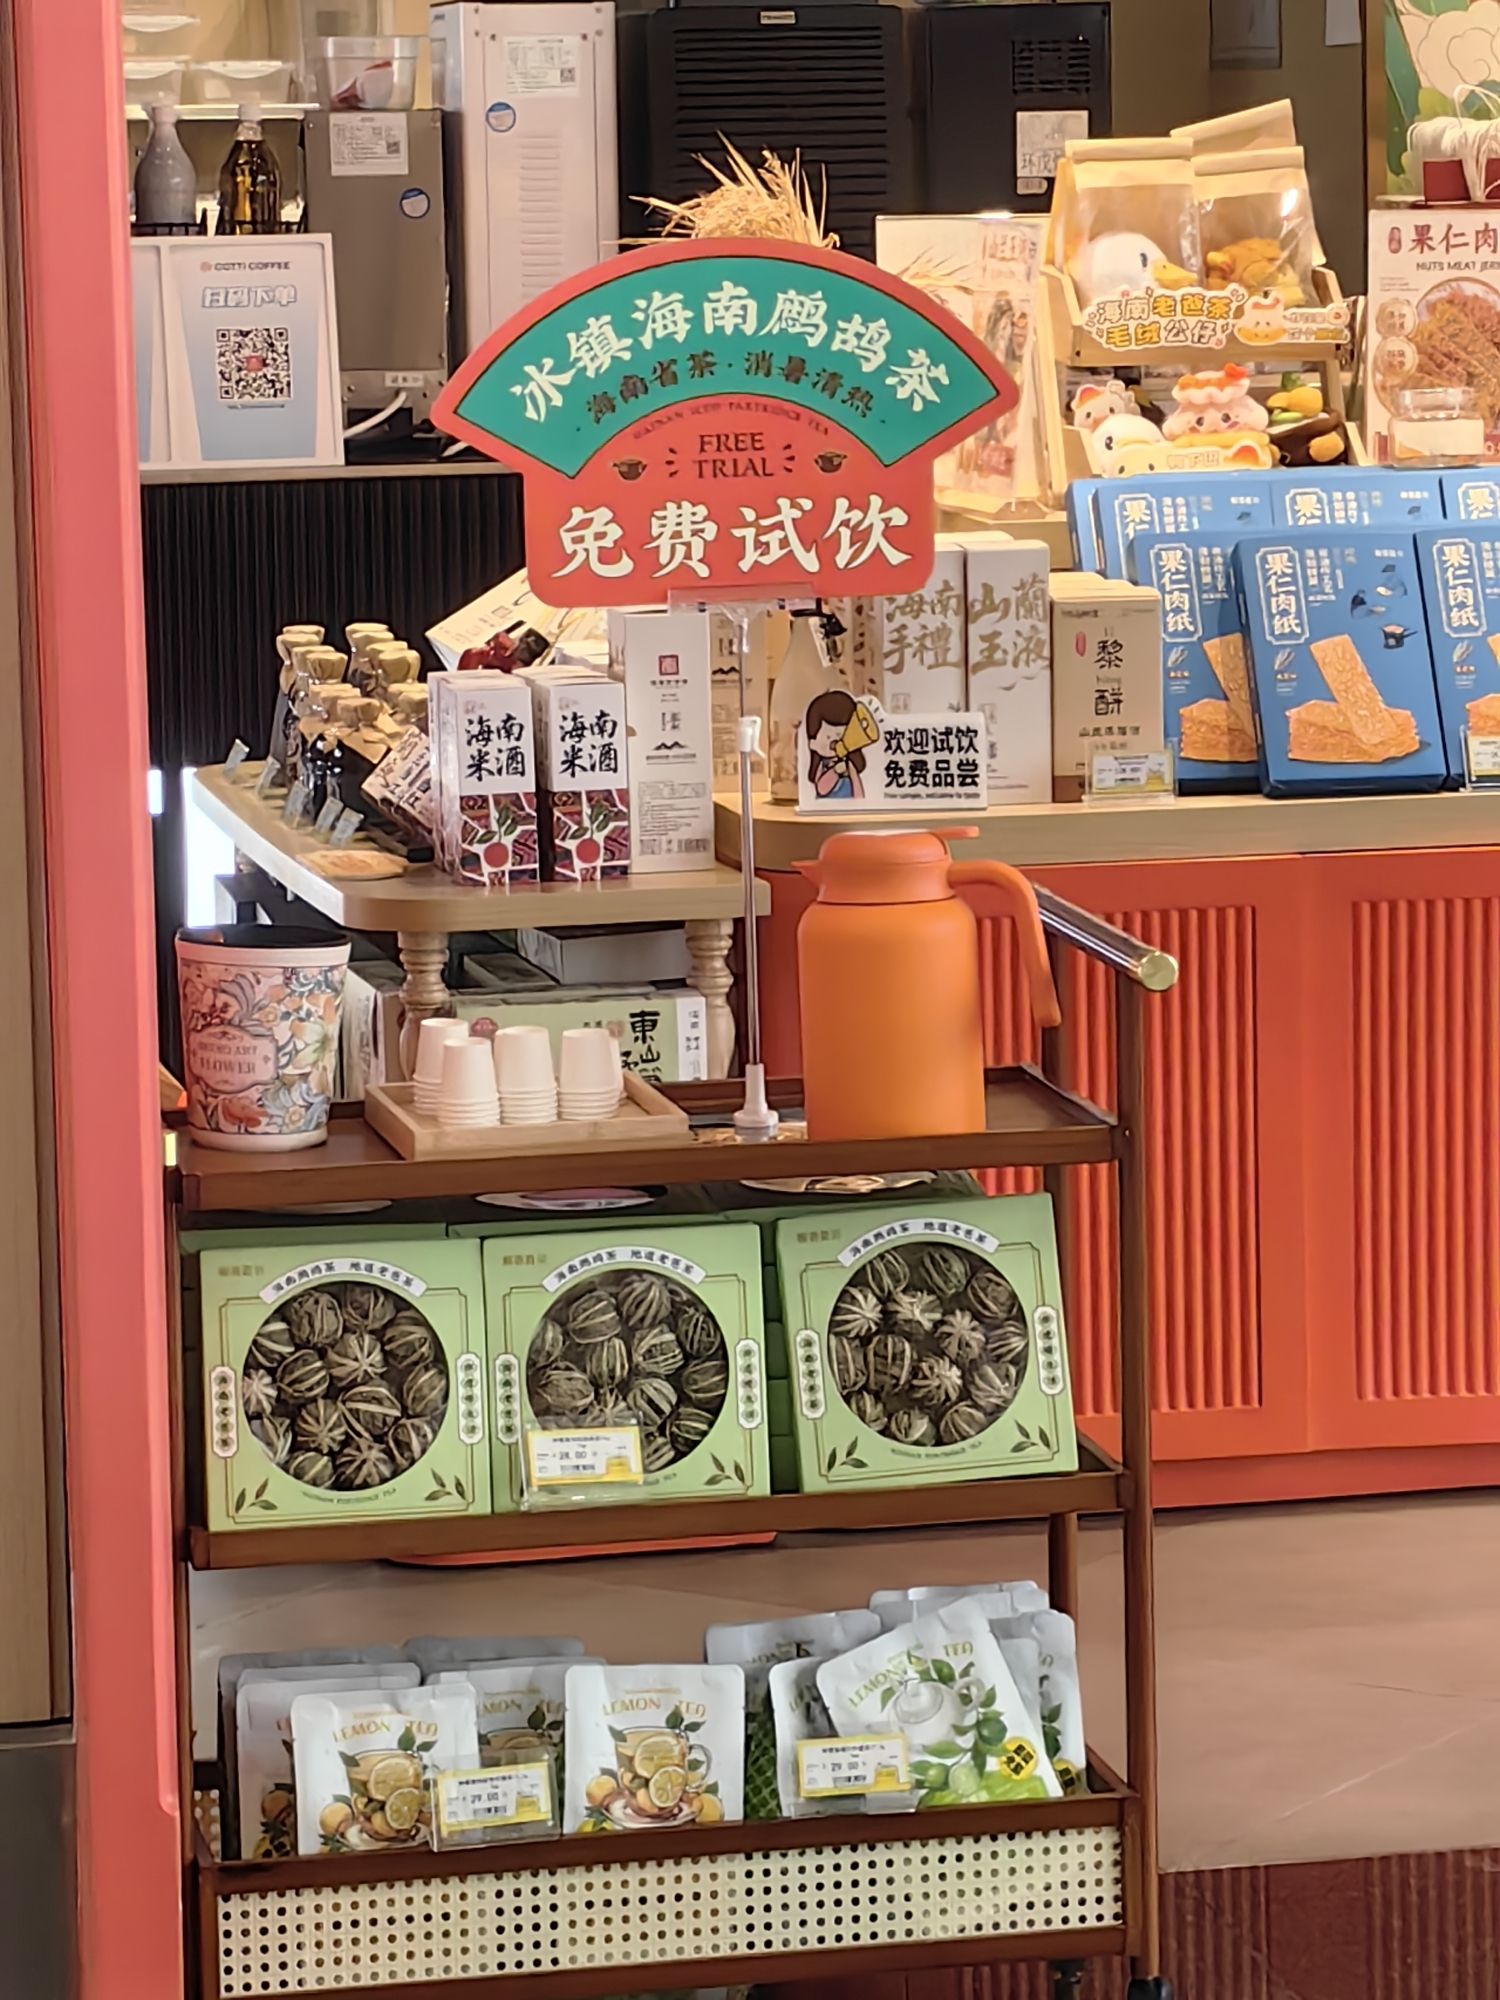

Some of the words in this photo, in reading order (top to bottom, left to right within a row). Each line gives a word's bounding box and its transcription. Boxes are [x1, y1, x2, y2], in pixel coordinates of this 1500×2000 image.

[1447, 260, 1476, 272] MEAT
[699, 431, 765, 453] FREE
[693, 456, 775, 480] TRIAL
[551, 493, 913, 580] 免费试饮
[1158, 549, 1195, 634] 果仁肉纸
[1264, 552, 1302, 636] 果仁肉纸
[1441, 544, 1480, 628] 果仁肉纸
[464, 712, 525, 748] 海南
[558, 708, 619, 745] 海南
[883, 725, 980, 755] 欢迎试饮
[464, 745, 527, 782] 米酒
[558, 742, 620, 780] 米酒
[884, 758, 981, 788] 免费品尝
